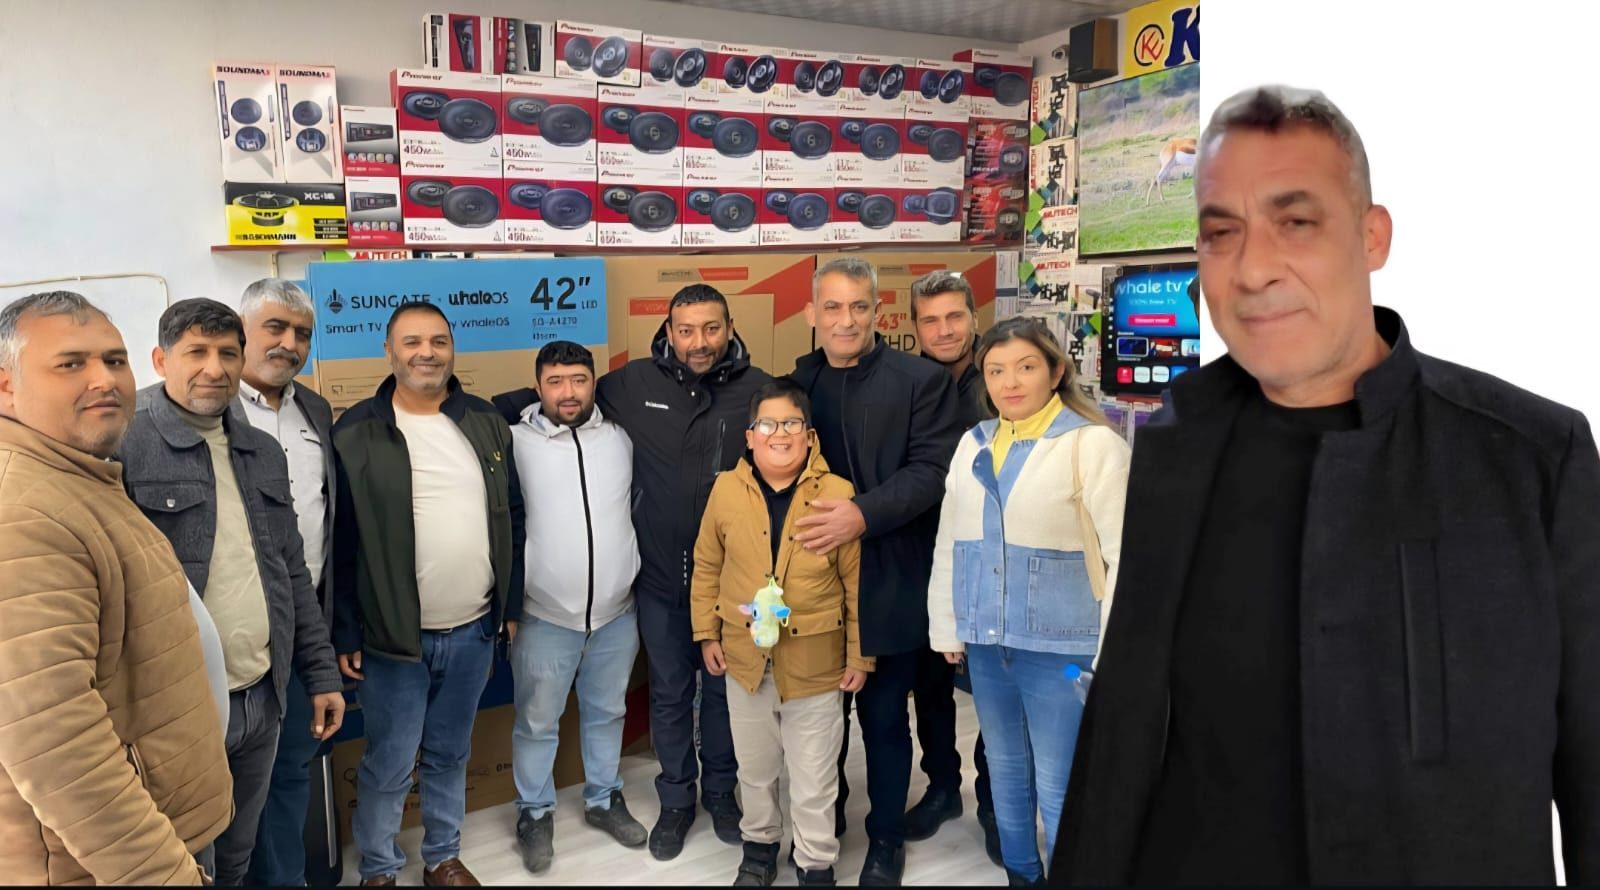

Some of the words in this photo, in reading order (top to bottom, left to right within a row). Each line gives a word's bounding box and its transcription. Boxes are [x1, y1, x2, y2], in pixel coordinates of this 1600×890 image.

[560, 23, 594, 32] Pioneer
[401, 71, 442, 80] Pioneer
[405, 161, 444, 169] Pioneer
[507, 165, 544, 174] Pioneer
[1042, 207, 1077, 219] MUTECH
[1036, 260, 1071, 270] MUTECH
[1115, 279, 1162, 294] whale
[1166, 280, 1182, 292] tv
[530, 276, 590, 310] 42"
[351, 294, 431, 308] SUNGATE
[326, 323, 363, 334] Smart
[368, 322, 382, 332] TV
[883, 334, 916, 352] HD
